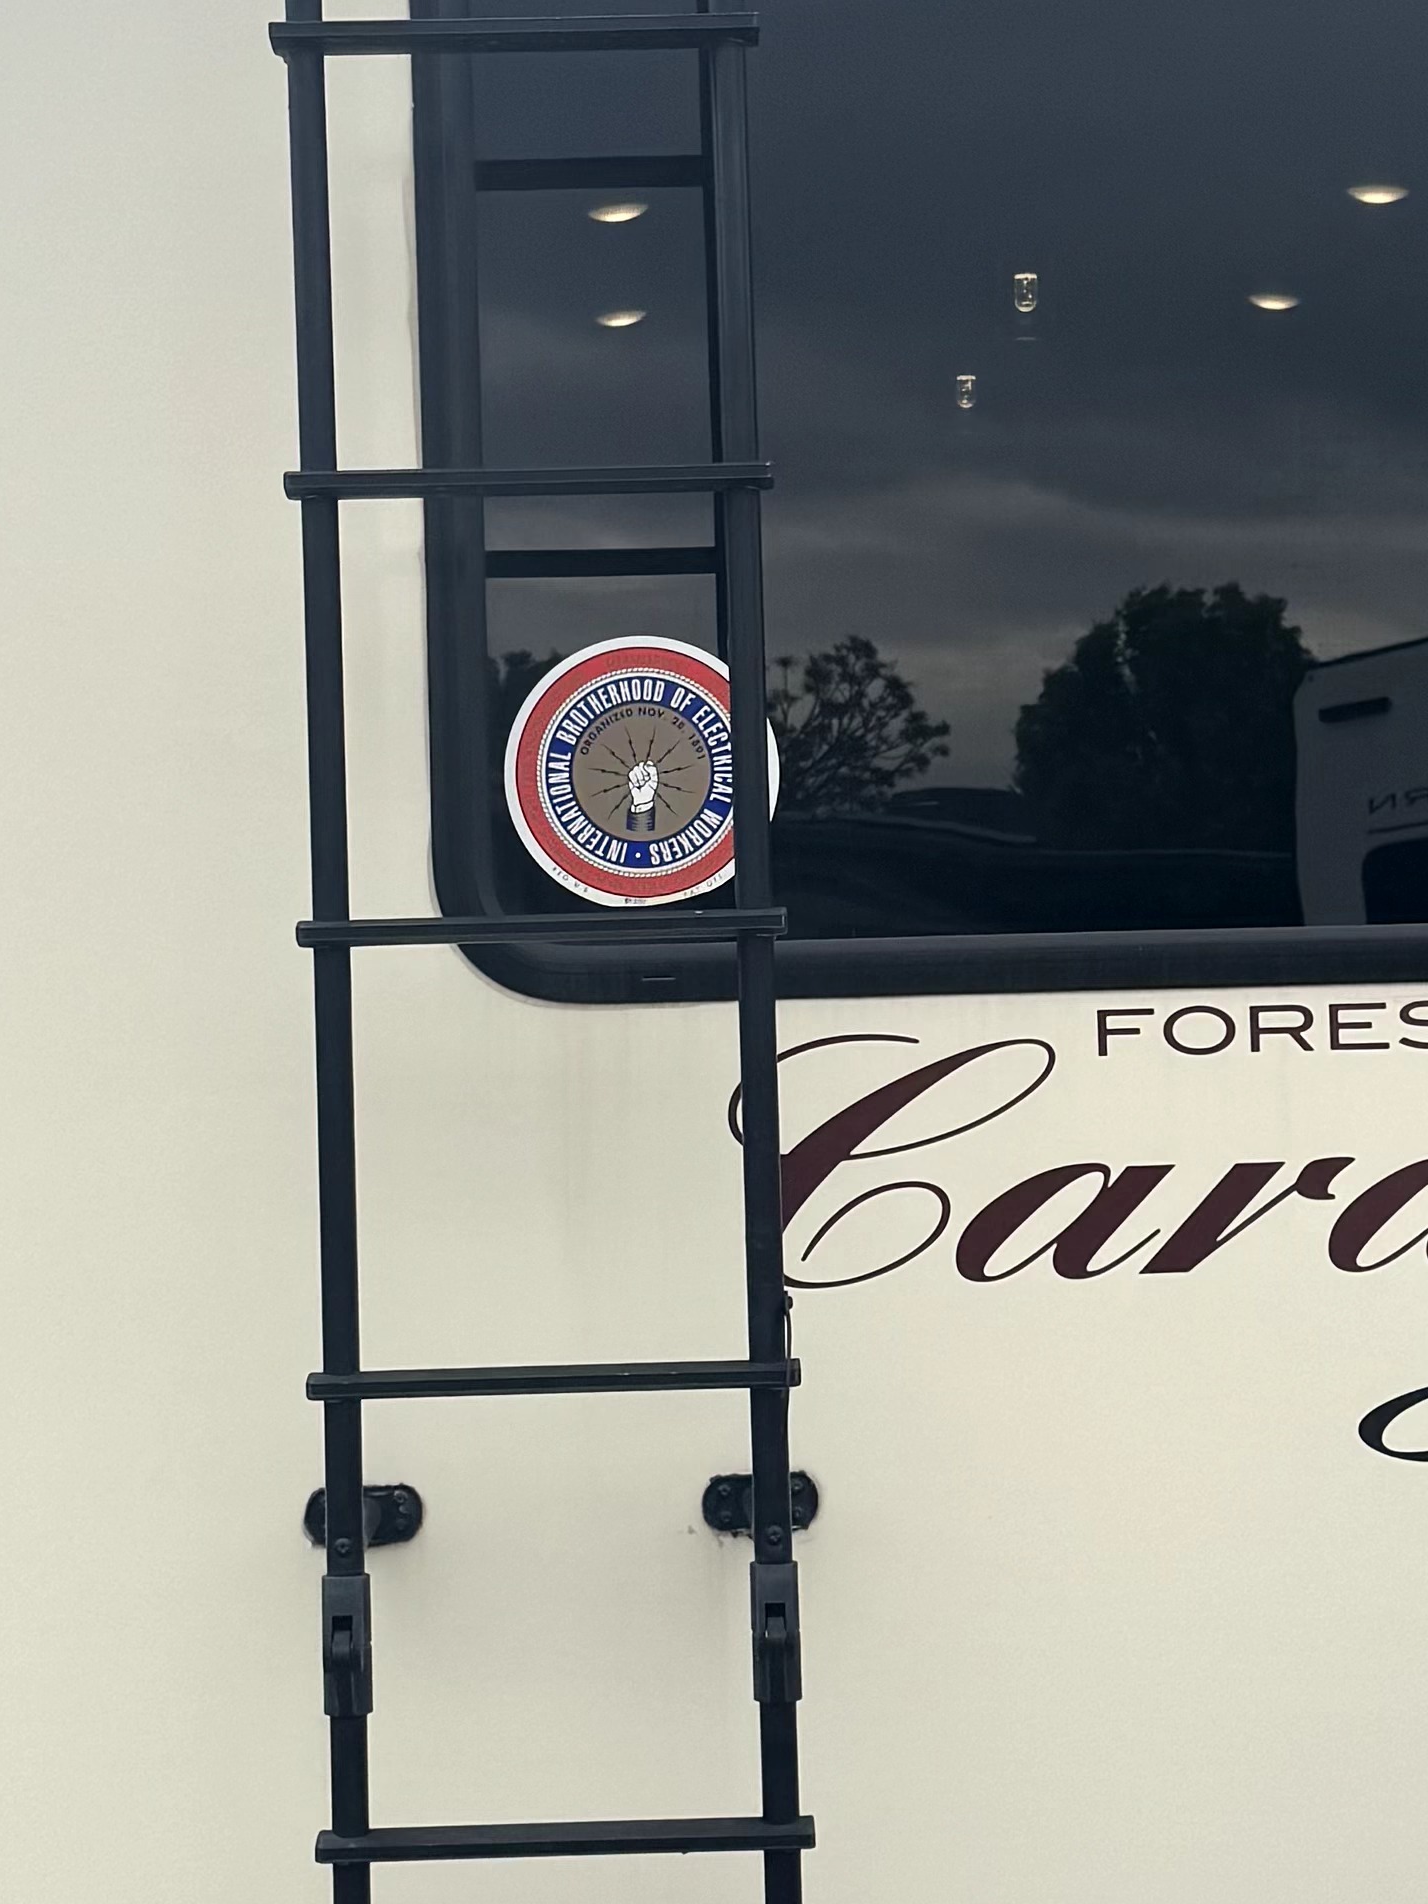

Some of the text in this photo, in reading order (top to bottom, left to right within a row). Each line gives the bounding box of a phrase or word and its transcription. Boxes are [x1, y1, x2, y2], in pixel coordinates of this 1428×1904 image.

[557, 678, 666, 746] BROTHERHOOD
[670, 687, 696, 712] OF
[691, 704, 733, 803] ELECTRICAL
[548, 751, 628, 865] INTERNATIONAL
[649, 807, 724, 866] WORKERS
